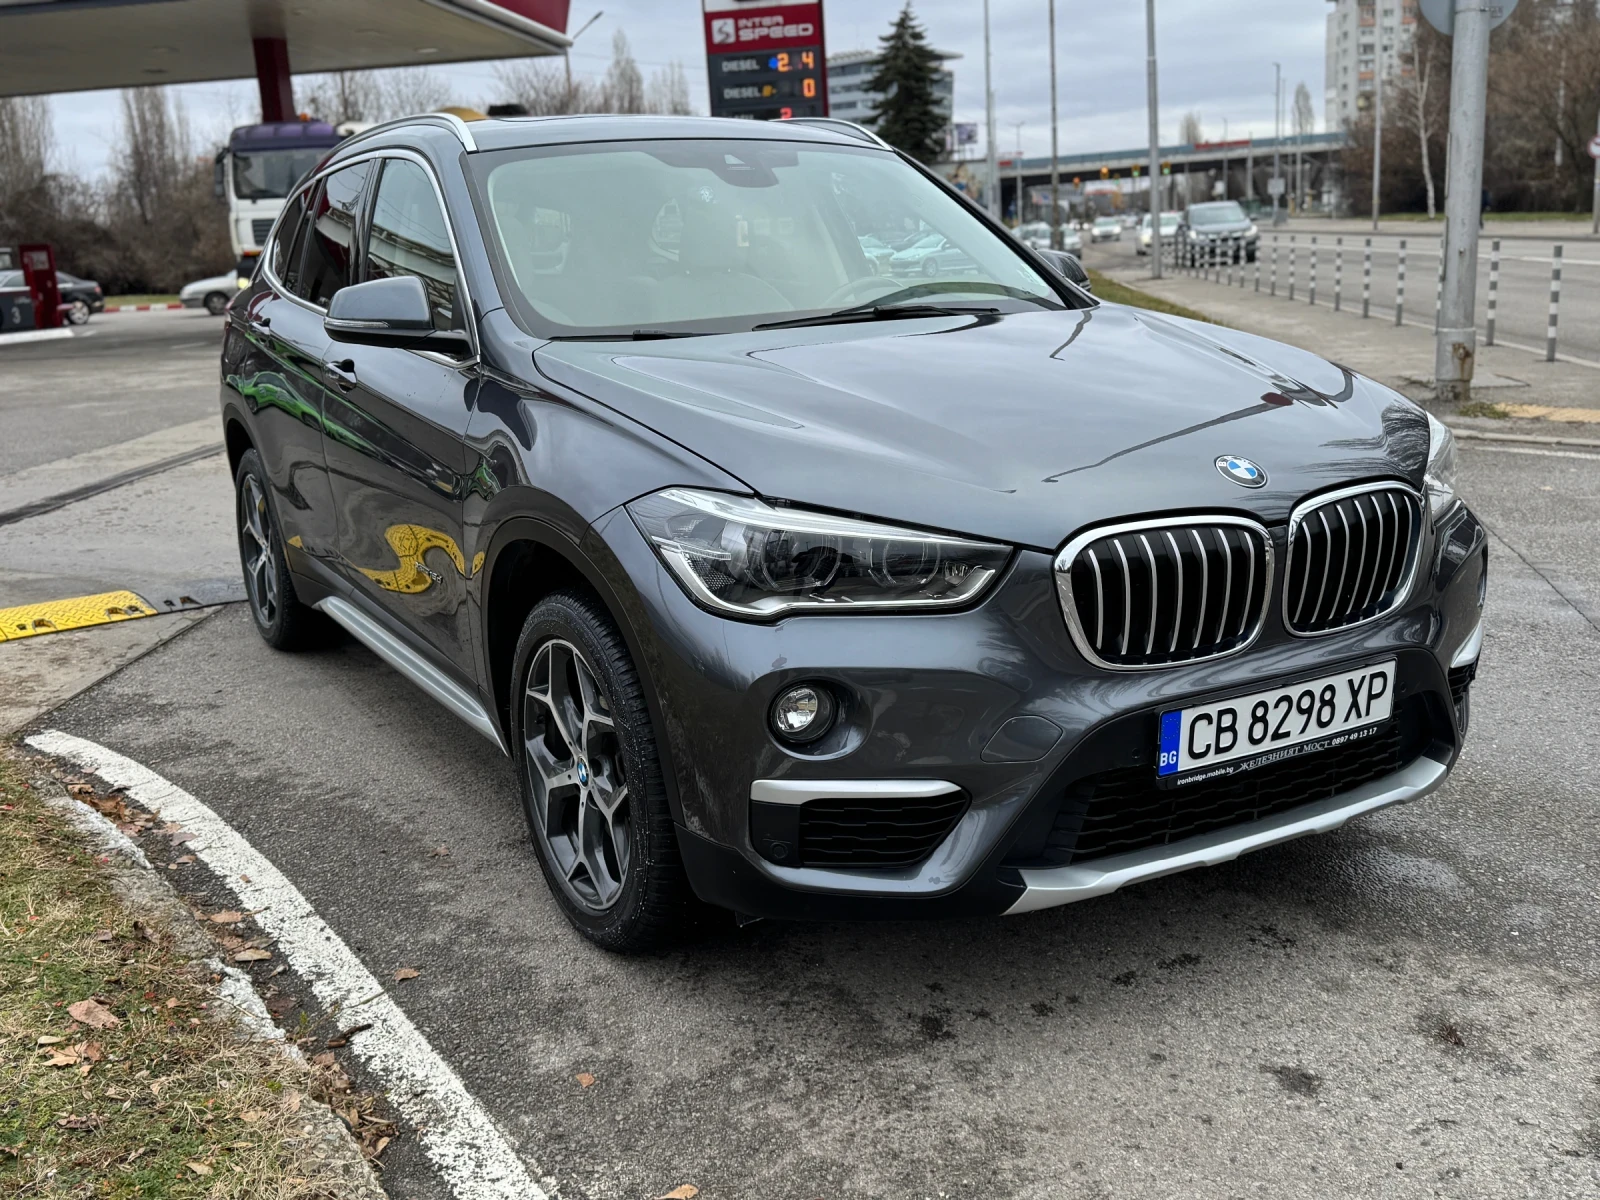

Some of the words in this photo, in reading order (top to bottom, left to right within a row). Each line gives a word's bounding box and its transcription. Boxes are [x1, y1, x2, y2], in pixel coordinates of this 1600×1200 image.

[738, 16, 783, 28] INTER
[738, 23, 814, 41] SPEED
[722, 59, 760, 72] DIESEL
[723, 87, 761, 99] DIESEL
[1247, 684, 1336, 745] 8298
[1331, 735, 1349, 746] 0897
[1349, 732, 1359, 740] 49
[1359, 729, 1368, 737] 13
[1368, 727, 1378, 735] 17
[1160, 751, 1177, 767] BG
[1240, 747, 1301, 771] ЖЕЛЕЗНИЯТ
[1302, 740, 1330, 754] МОСТ
[1177, 767, 1234, 785] ironbridge.mobile.bg
